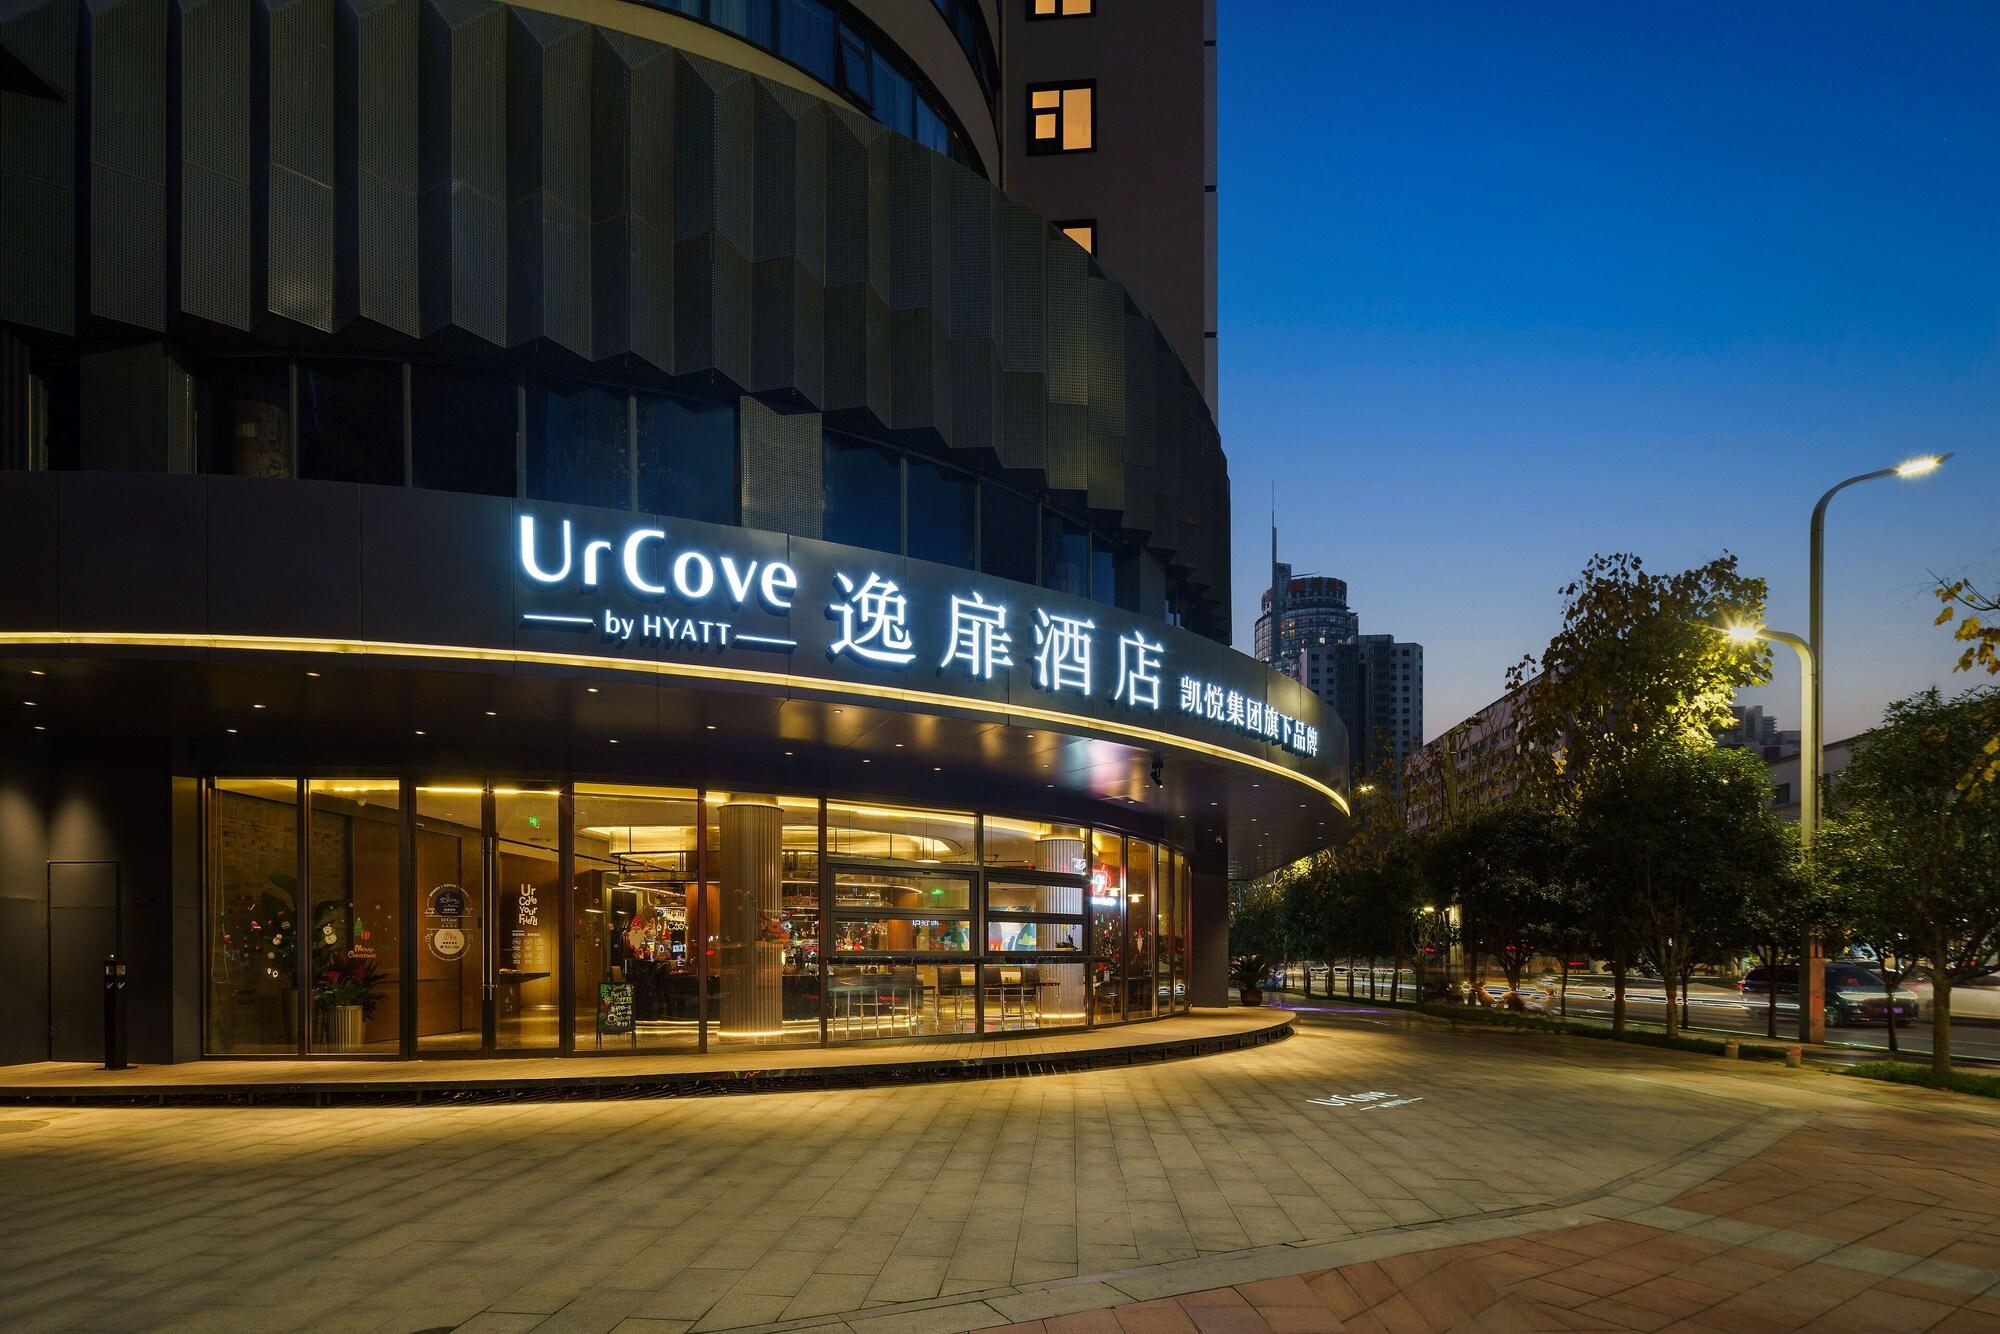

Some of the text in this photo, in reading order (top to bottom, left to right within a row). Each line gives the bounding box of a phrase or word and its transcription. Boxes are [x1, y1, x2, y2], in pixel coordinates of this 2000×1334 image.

[520, 515, 798, 608] UrCove
[605, 609, 732, 645] by HYATT
[829, 571, 1165, 710] 逸扉酒店
[1180, 675, 1318, 757] 凯悦集团旗下品牌
[521, 884, 537, 896] Ur
